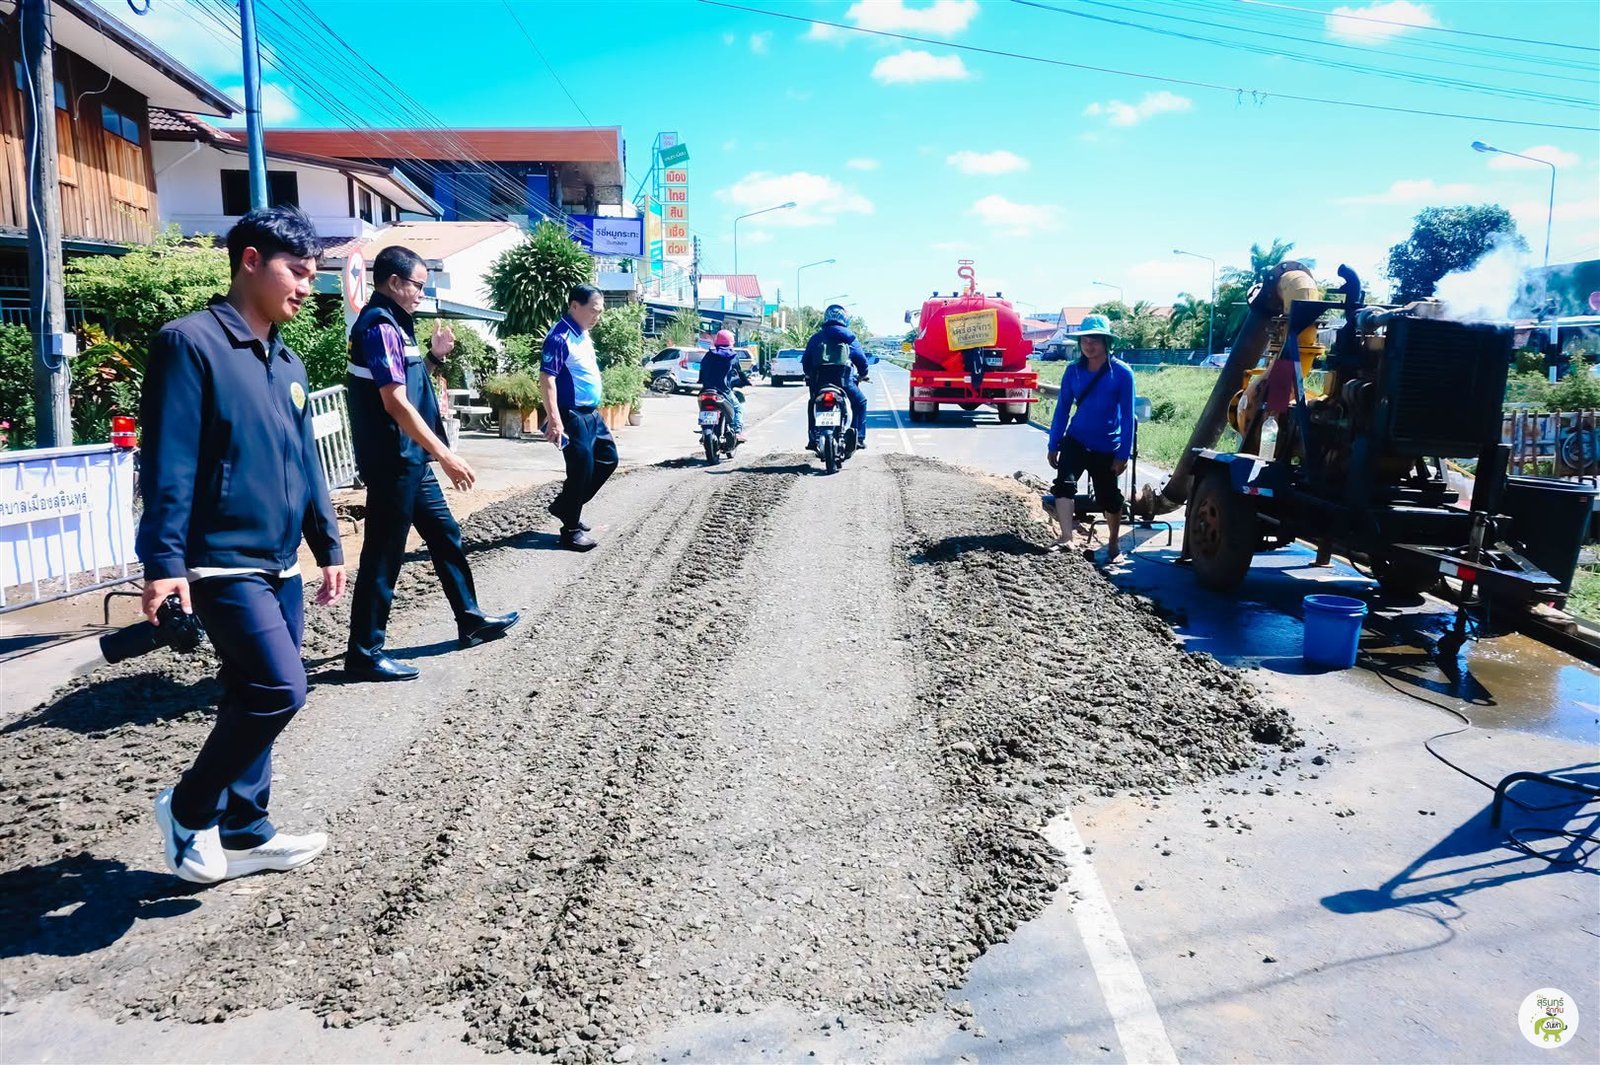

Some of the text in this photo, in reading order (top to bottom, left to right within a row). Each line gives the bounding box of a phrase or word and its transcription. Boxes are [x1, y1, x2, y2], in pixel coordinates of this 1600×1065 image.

[666, 171, 687, 182] เมือง
[668, 188, 686, 201] ไทย
[669, 223, 685, 237] เชื่อ
[668, 243, 686, 254] ด่วน
